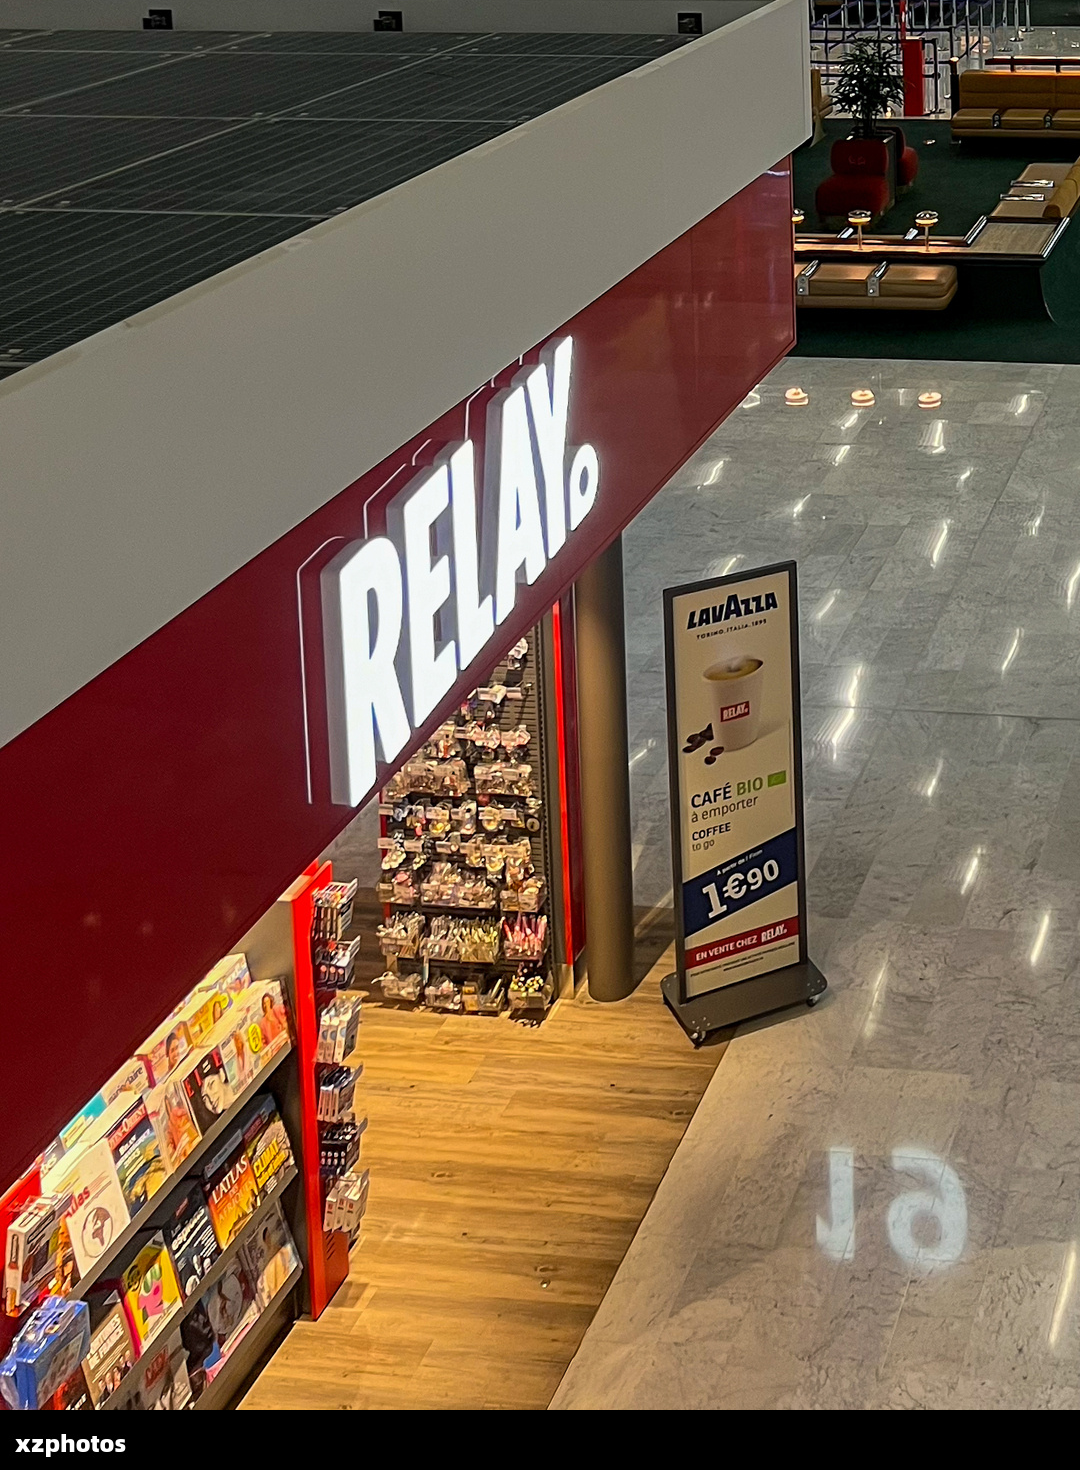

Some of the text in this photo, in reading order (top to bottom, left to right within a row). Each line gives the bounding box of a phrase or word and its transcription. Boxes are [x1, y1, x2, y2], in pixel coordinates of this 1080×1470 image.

[686, 592, 778, 630] LAVAZZA
[691, 777, 763, 809] CAFÉ BIO
[691, 796, 759, 823] à emporter
[692, 822, 731, 841] COFFEE
[692, 839, 715, 851] to go
[695, 951, 708, 962] EN
[709, 942, 735, 957] VENTE
[736, 935, 758, 948] CHEZ
[211, 1155, 248, 1204] L'ATLAS
